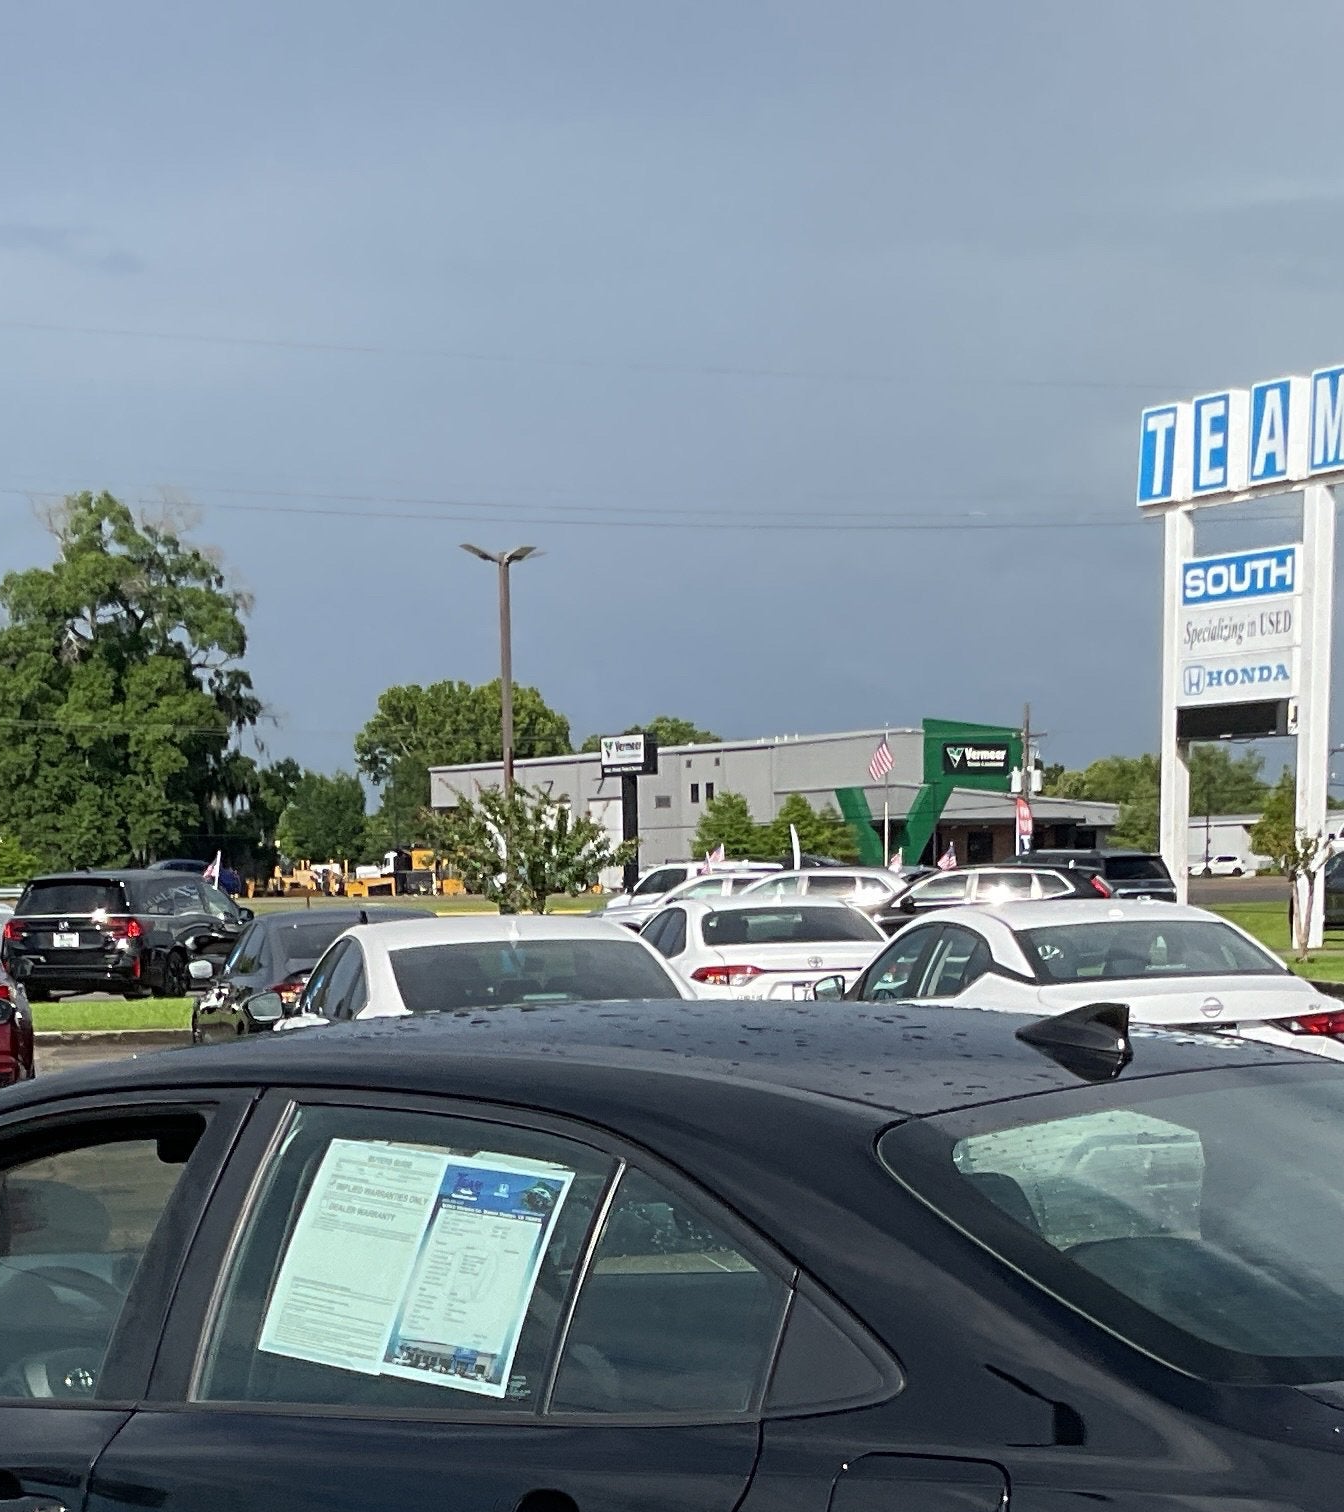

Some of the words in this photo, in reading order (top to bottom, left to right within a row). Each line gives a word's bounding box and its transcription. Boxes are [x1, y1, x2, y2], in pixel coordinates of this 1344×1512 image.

[1184, 555, 1293, 599] SOUTH
[1183, 616, 1245, 651] Specializing
[1246, 615, 1257, 638] in
[1259, 609, 1292, 636] USED
[1206, 663, 1290, 687] HONDA
